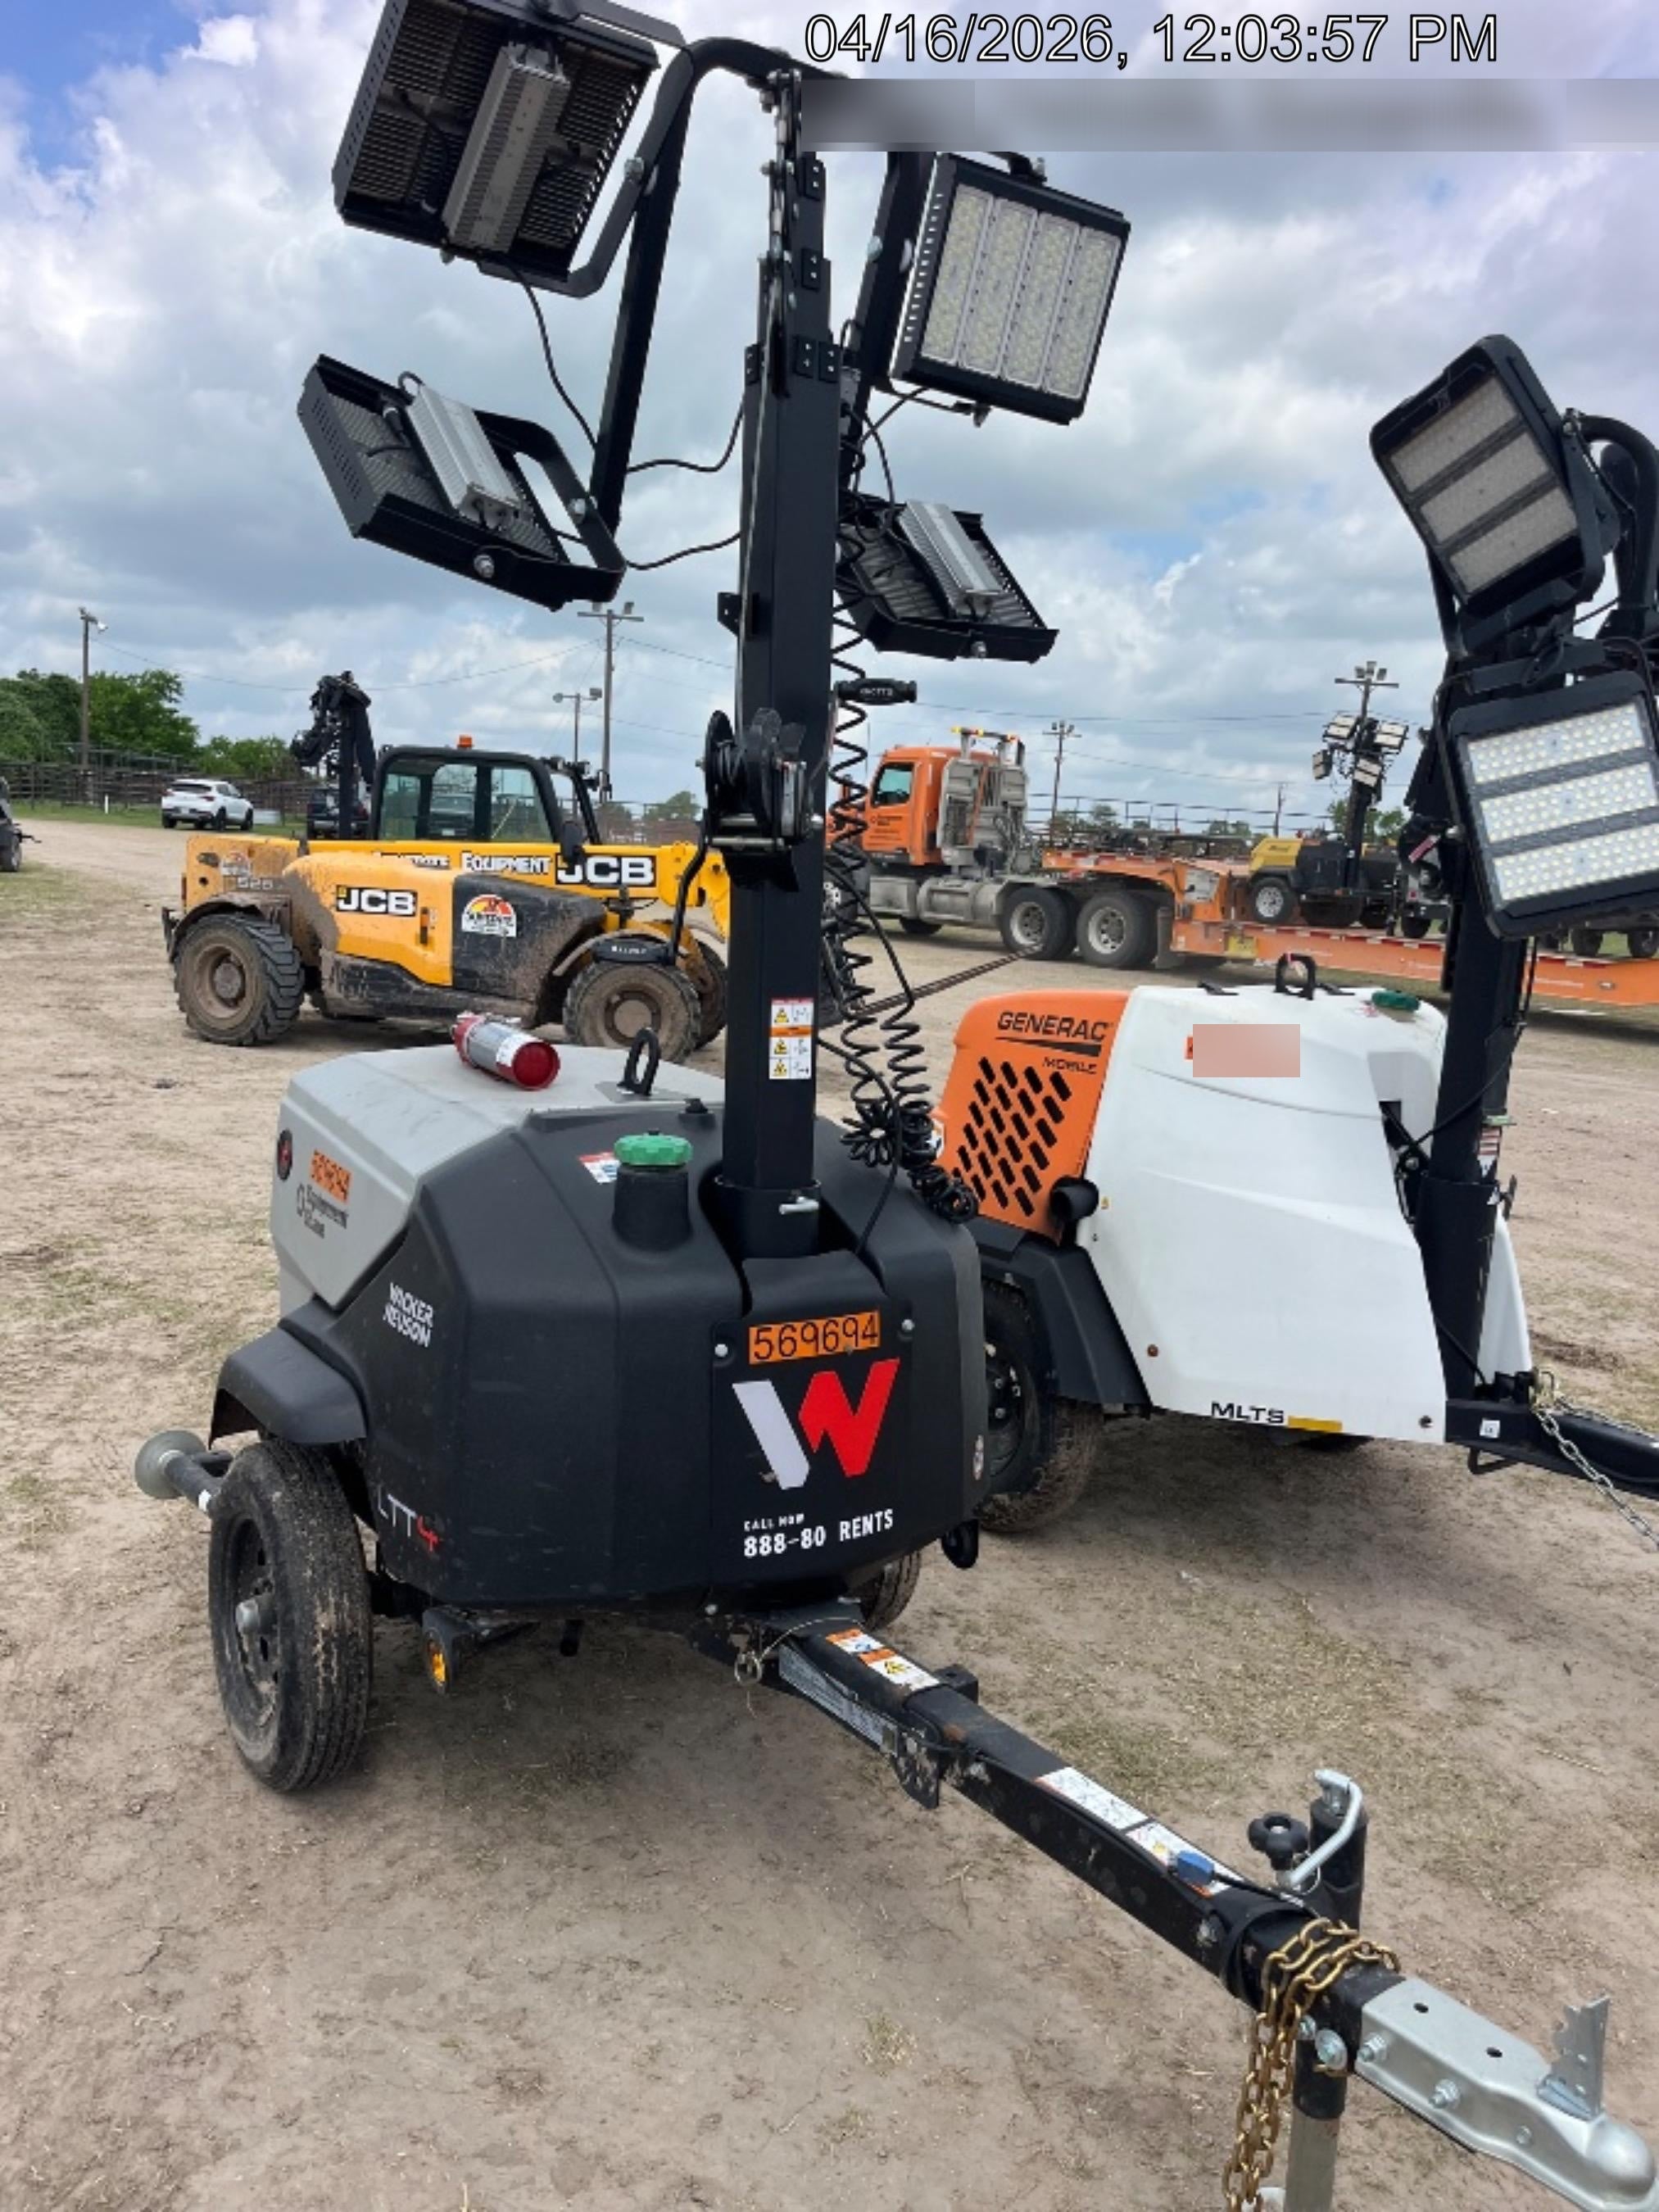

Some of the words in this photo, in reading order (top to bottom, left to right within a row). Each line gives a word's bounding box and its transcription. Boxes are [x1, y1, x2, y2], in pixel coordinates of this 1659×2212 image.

[558, 856, 654, 885] JCB
[338, 888, 415, 915] JCB
[997, 1011, 1106, 1040] GENERAC
[390, 1282, 433, 1328] WACKER
[383, 1303, 431, 1348] NEUSON
[753, 1313, 879, 1361] 569694
[1211, 1401, 1284, 1423] MLTS
[744, 1518, 774, 1532] CALL
[744, 1525, 827, 1557] 888-80
[839, 1508, 893, 1542] RENTS
